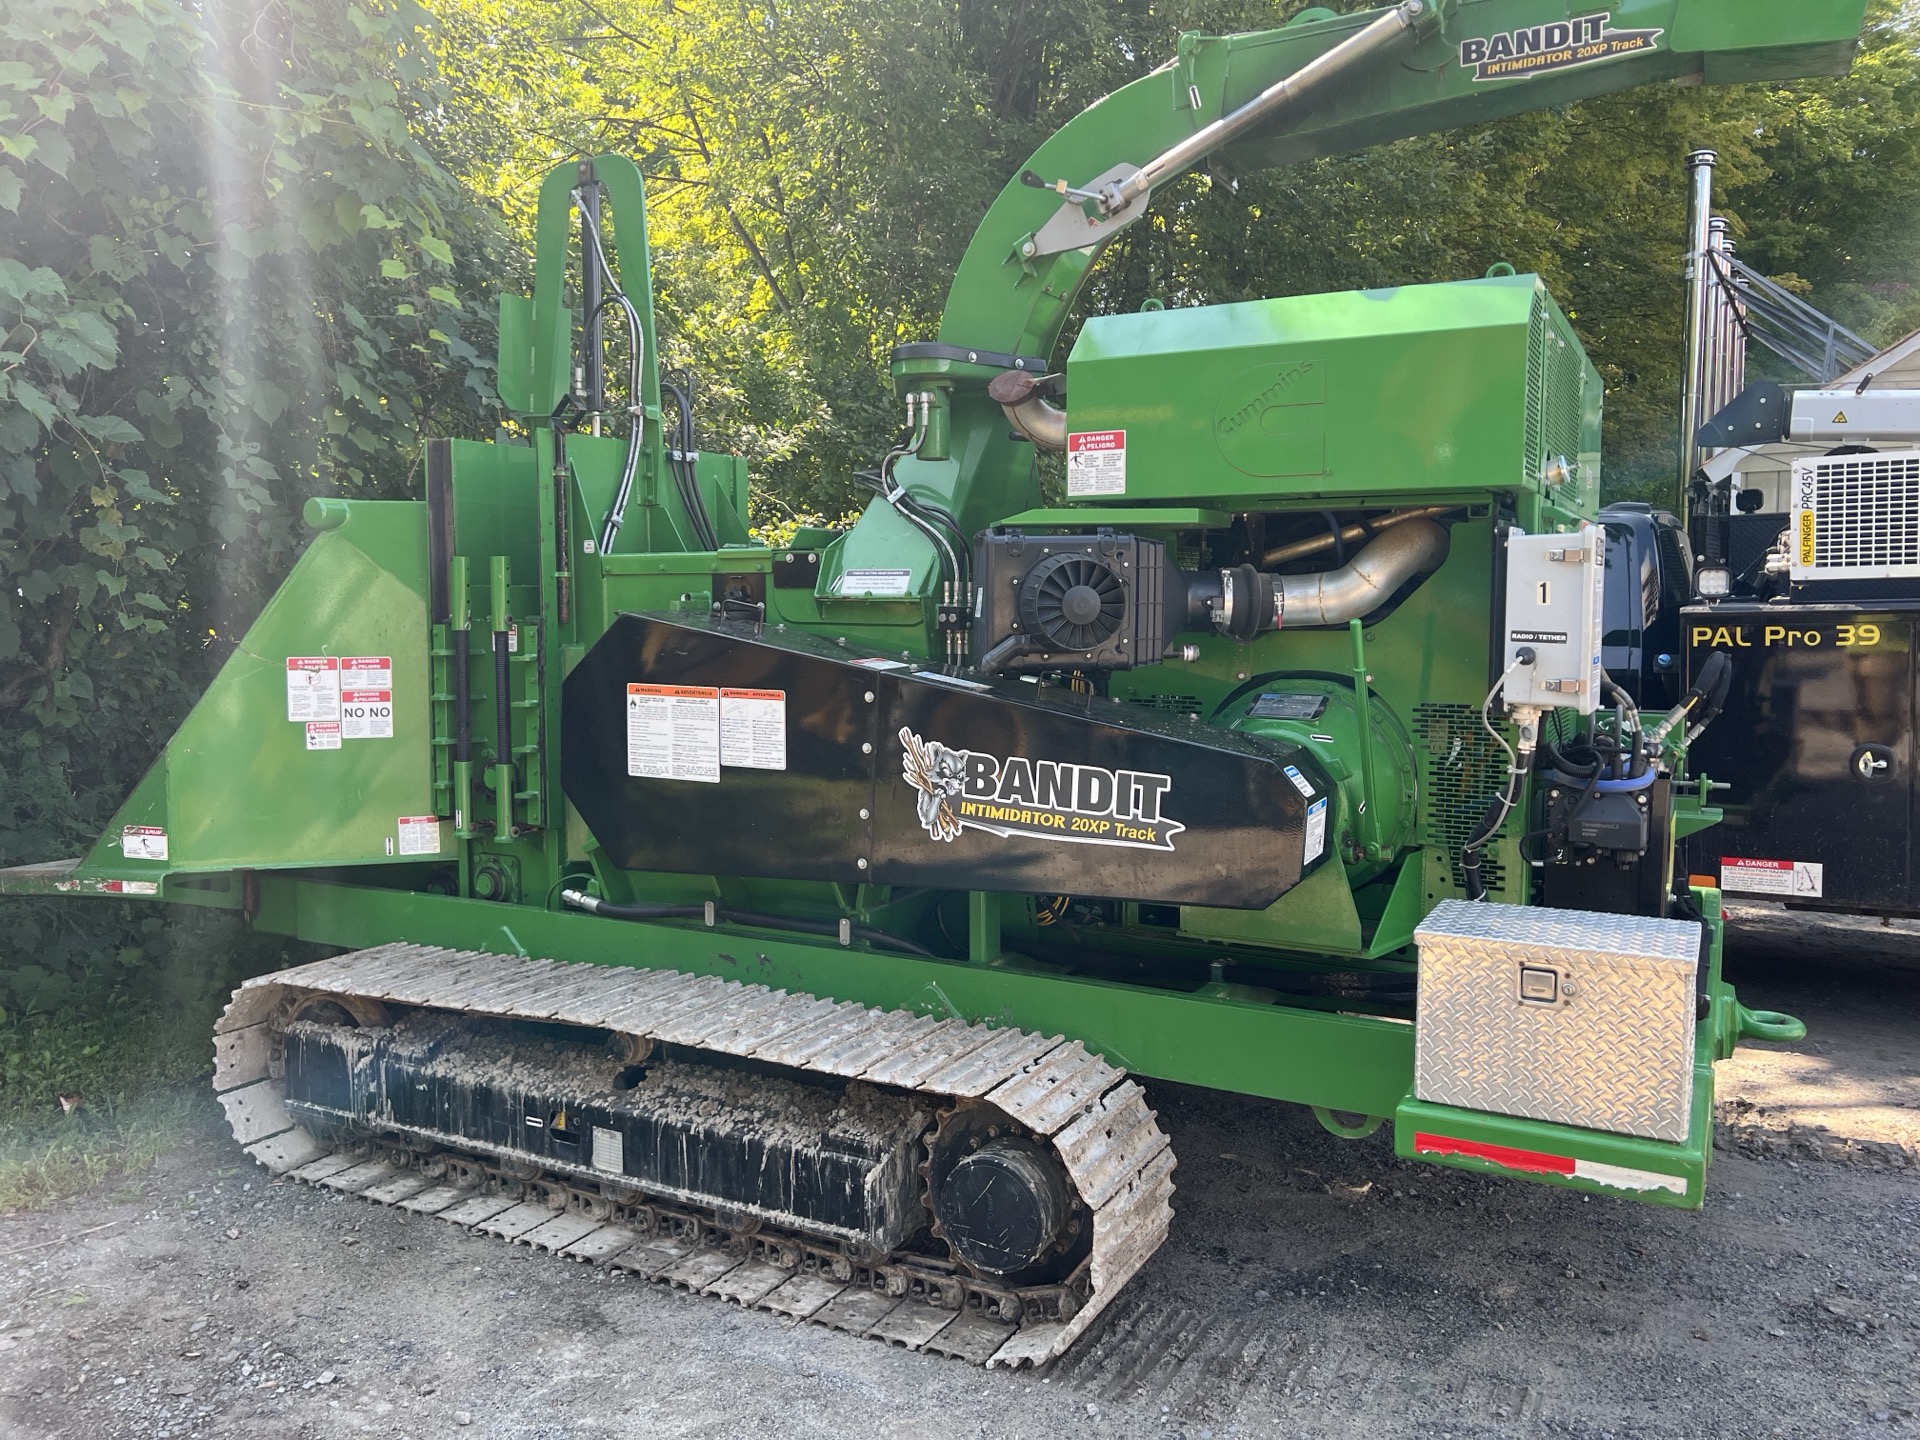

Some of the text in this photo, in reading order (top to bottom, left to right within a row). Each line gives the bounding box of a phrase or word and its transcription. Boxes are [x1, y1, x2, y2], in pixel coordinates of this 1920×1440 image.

[1460, 12, 1610, 67] BANDIT
[1487, 36, 1645, 76] INTIMIDATOR 20XP Track
[1215, 359, 1315, 436] Cummins
[1801, 467, 1814, 510] PRC45V
[1802, 514, 1812, 563] PALFINGER
[1539, 581, 1547, 604] 1
[1692, 624, 1881, 648] PAL Pro 39
[344, 707, 390, 718] NO NO
[962, 752, 1172, 821] BANDIT
[959, 801, 1157, 842] INTIMIDATOR 20XP Track
[1745, 860, 1779, 868] DANGER
